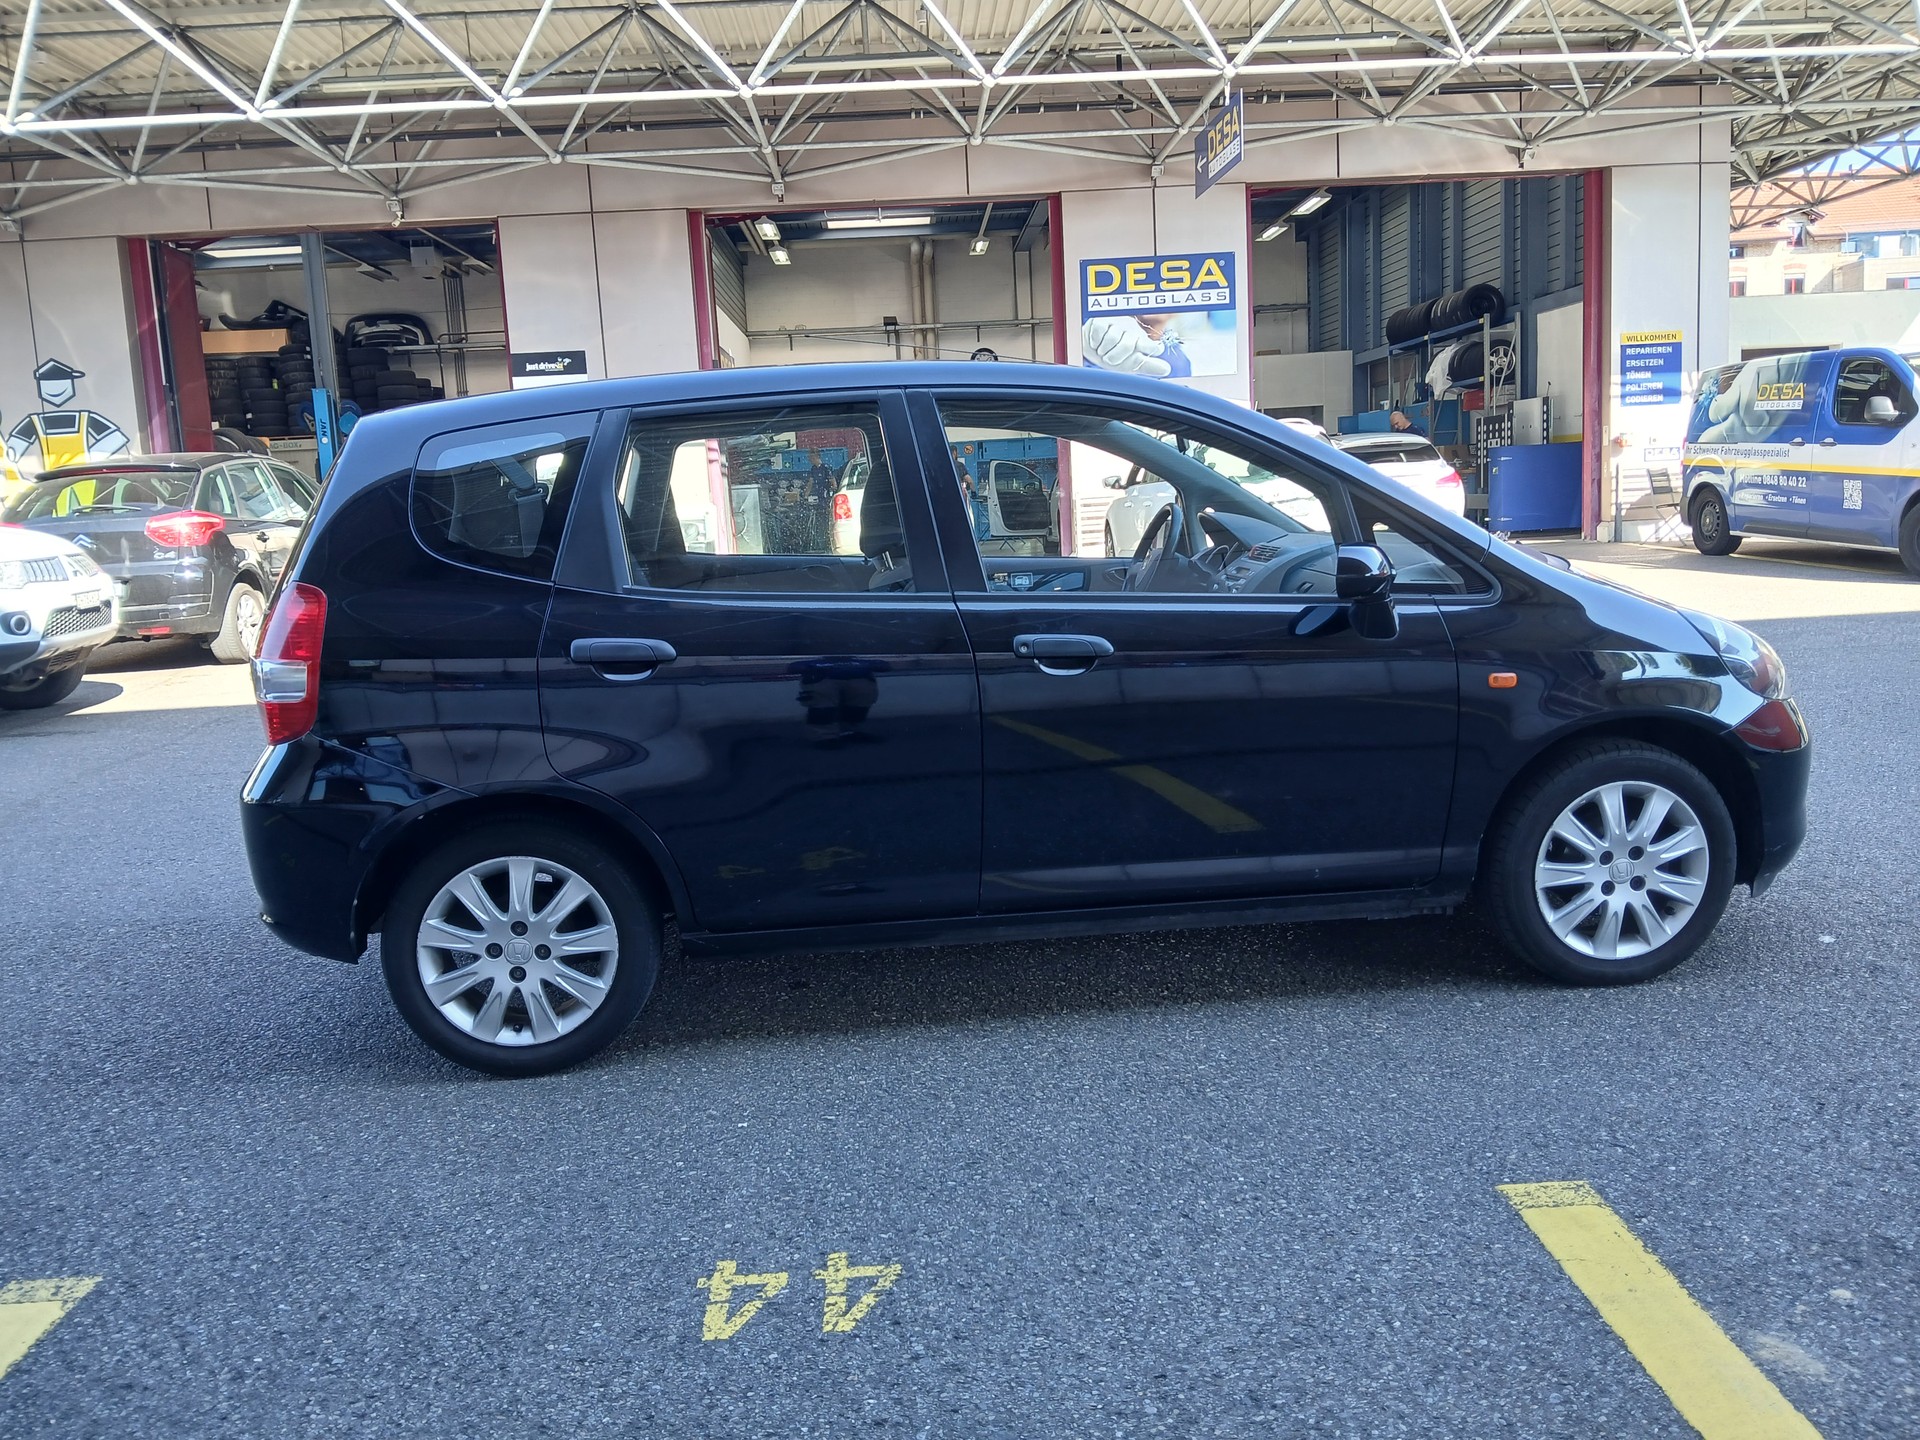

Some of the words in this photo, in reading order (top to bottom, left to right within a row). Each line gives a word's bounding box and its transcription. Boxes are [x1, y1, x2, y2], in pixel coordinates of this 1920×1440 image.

[1207, 104, 1239, 162] DESA
[1087, 258, 1228, 294] DESA
[1090, 291, 1227, 308] AUTOGLASS
[1626, 333, 1677, 342] WILLKOMMEN
[1626, 346, 1673, 355] REPARIEREN
[1626, 358, 1664, 367] ERSETZEN
[1626, 370, 1651, 379] TÖNEN
[1626, 382, 1663, 391] POLIEREN
[1757, 382, 1804, 400] DESA
[1693, 446, 1719, 455] Schweizer
[1720, 446, 1790, 458] Fahrzeugglasspezialist
[1763, 475, 1778, 486] 0848
[1788, 476, 1797, 487] 40
[1798, 477, 1806, 487] 22
